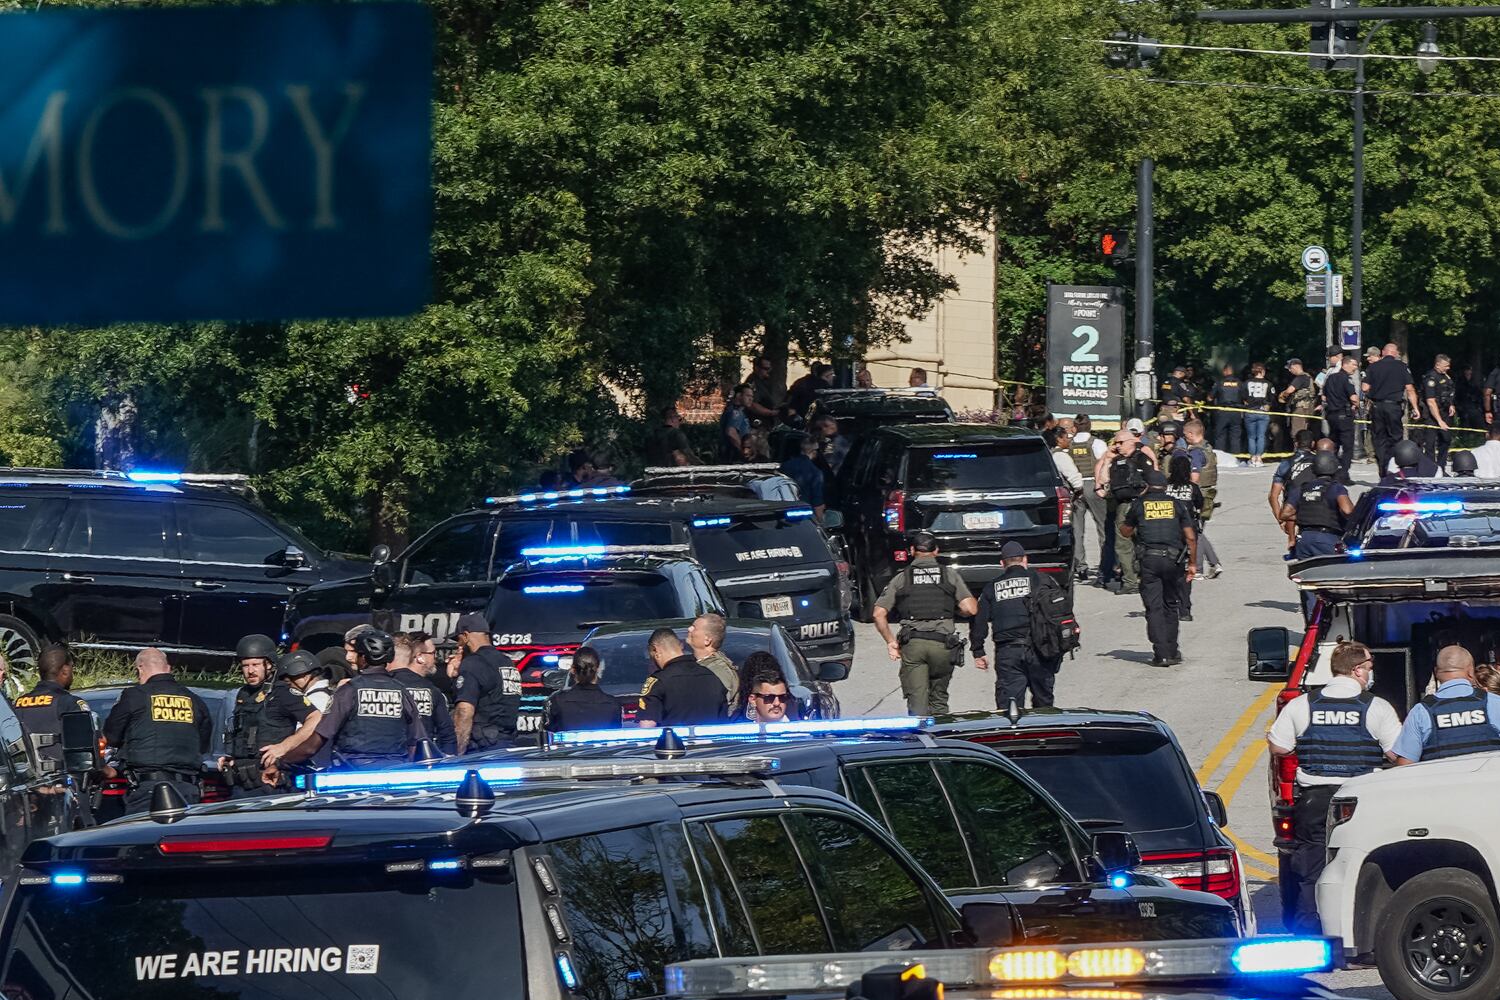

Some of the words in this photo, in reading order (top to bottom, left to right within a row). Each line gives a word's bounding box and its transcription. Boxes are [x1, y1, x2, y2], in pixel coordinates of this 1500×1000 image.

[1070, 325, 1099, 362] 2
[1095, 365, 1108, 374] OF
[1062, 374, 1109, 388] FREE
[1062, 388, 1109, 399] PARKING
[1146, 510, 1174, 518] POLICE
[996, 577, 1029, 591] ATLANTA
[997, 587, 1030, 601] POLICE
[800, 621, 840, 640] POLICE
[16, 695, 53, 708] POLICE
[153, 697, 191, 709] ATLANTA
[360, 690, 401, 703] ATLANTA
[154, 708, 192, 721] POLICE
[360, 703, 401, 716] POLICE
[1312, 711, 1360, 725] EMS
[1437, 709, 1486, 728] EMS
[134, 954, 178, 981] WE
[181, 950, 240, 977] ARE
[245, 947, 343, 974] HIRING
